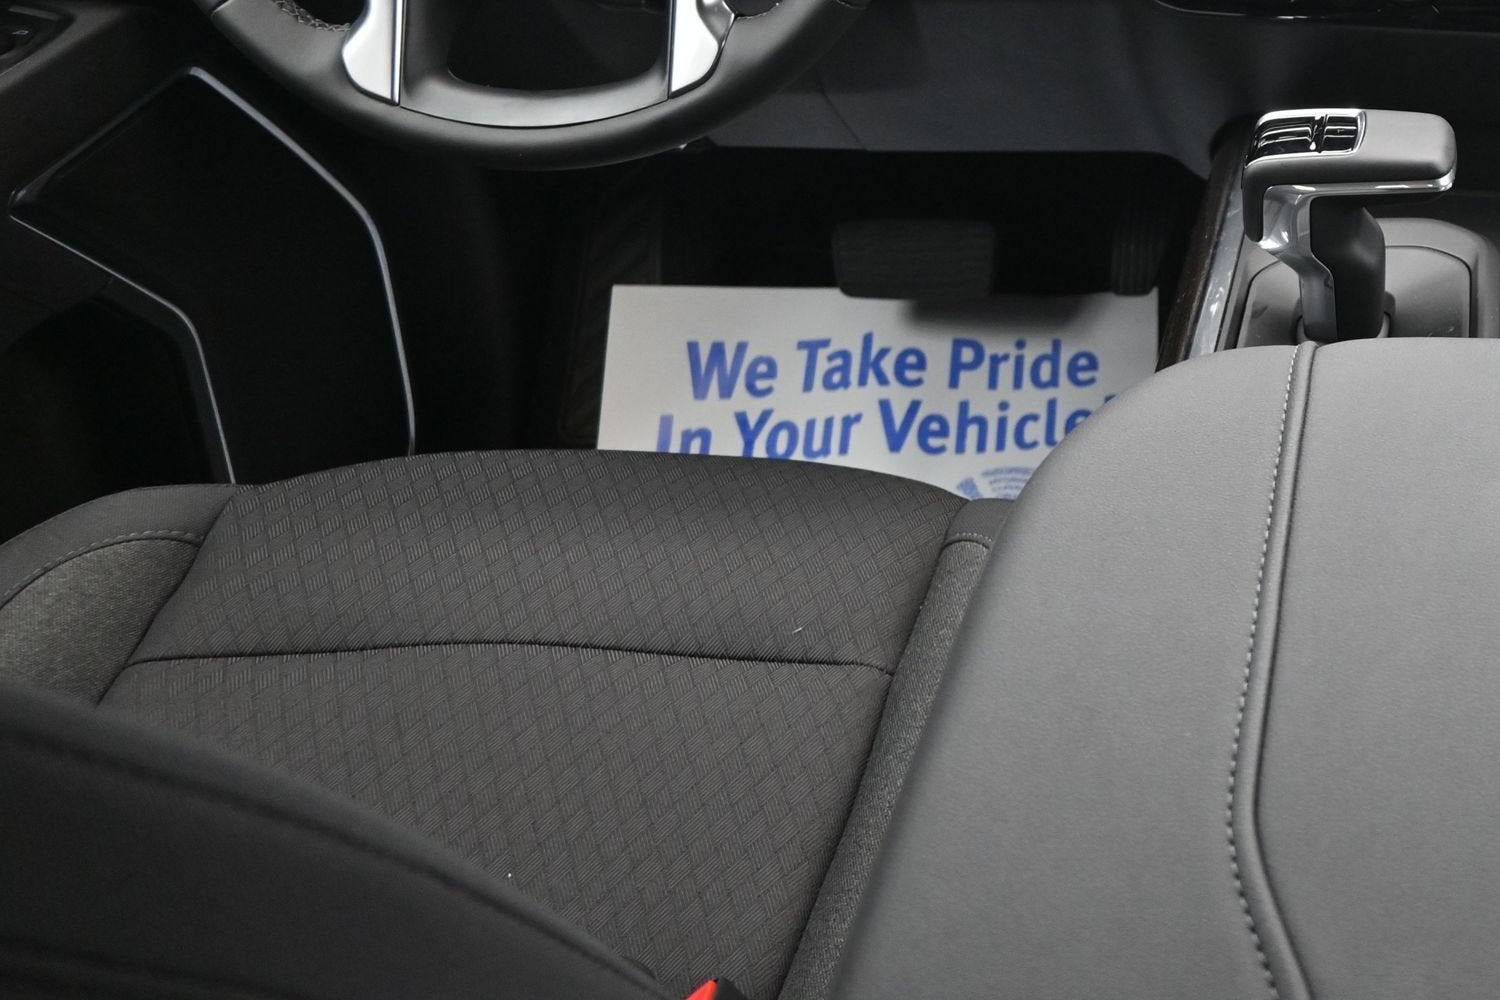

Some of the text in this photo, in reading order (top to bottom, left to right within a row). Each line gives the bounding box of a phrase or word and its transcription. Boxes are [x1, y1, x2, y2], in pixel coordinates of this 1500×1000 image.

[686, 332, 1099, 402] We Take Pride
[655, 393, 1113, 460] In Your Vehicle
